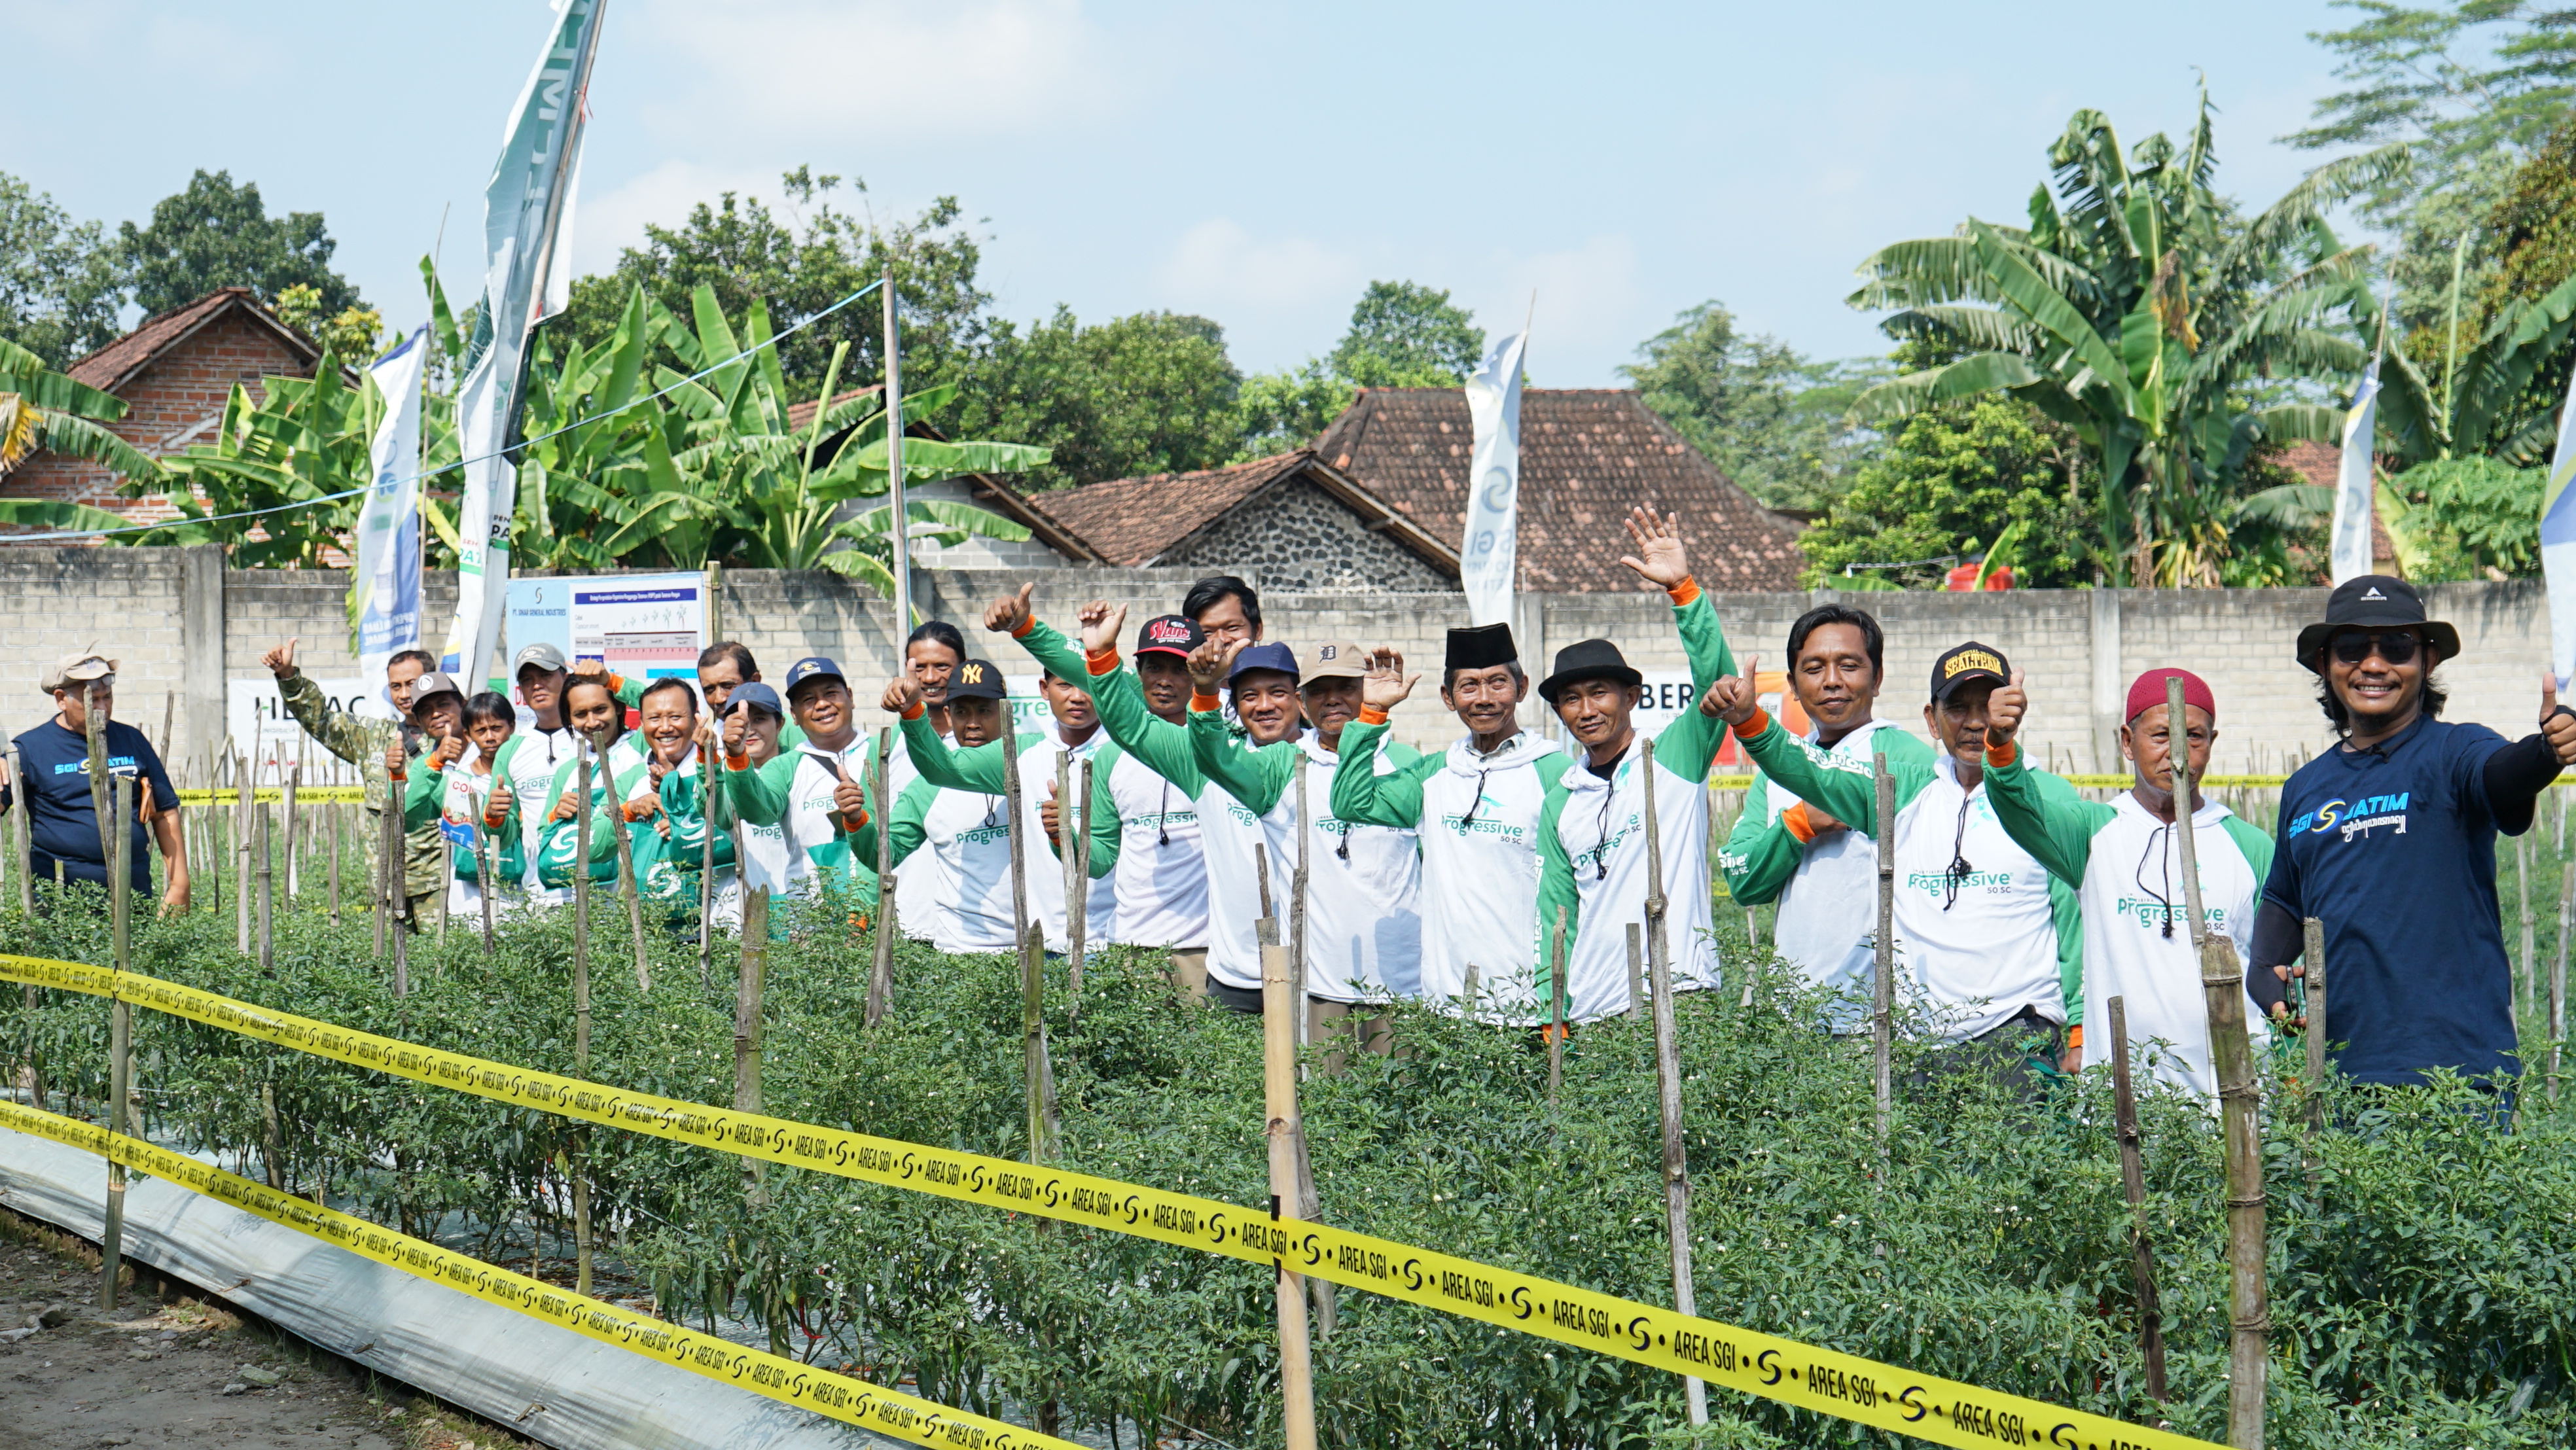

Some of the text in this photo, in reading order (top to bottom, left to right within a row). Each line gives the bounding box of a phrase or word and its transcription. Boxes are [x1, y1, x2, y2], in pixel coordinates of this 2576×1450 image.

[54, 756, 135, 775] SGI ATIM
[803, 799, 834, 811] Prog
[2289, 811, 2314, 839] SGI
[2342, 792, 2409, 822] JATIM
[753, 827, 782, 840] Prog
[1908, 872, 2011, 896] Progressive
[482, 1070, 495, 1089] AREA
[495, 1073, 506, 1091] SGI
[527, 1081, 541, 1099] AREA
[541, 1084, 552, 1102] SGI
[575, 1092, 590, 1110] AREA
[590, 1095, 602, 1113] SGI
[625, 1101, 642, 1122] AREA
[641, 1105, 656, 1125] SGI
[678, 1113, 694, 1133] AREA
[695, 1116, 707, 1136] SGI
[734, 1123, 751, 1145] AREA
[753, 1127, 764, 1148] SGI
[795, 1135, 813, 1158] AREA
[814, 1138, 827, 1161] SGI
[857, 1146, 876, 1170] AREA
[878, 1150, 892, 1173] SGI
[925, 1159, 944, 1183] AREA
[946, 1163, 961, 1186] SGI
[996, 1173, 1017, 1197] AREA
[1019, 1176, 1034, 1201] SGI
[1072, 1188, 1094, 1213] AREA
[1096, 1192, 1111, 1217] SGI
[1154, 1204, 1177, 1231] AREA
[1180, 1209, 1195, 1235] SGI
[1243, 1223, 1268, 1250] AREA
[1270, 1229, 1287, 1256] SGI
[1339, 1245, 1367, 1275] AREA
[1370, 1252, 1387, 1281] SGI
[1442, 1271, 1473, 1302] AREA
[1475, 1279, 1494, 1308] SGI
[1554, 1300, 1586, 1332] AREA
[1588, 1308, 1610, 1339] SGI
[1675, 1331, 1711, 1365] AREA
[1714, 1340, 1736, 1372] SGI
[1808, 1365, 1848, 1400] AREA
[1851, 1375, 1876, 1407] SGI
[1952, 1402, 1996, 1438] AREA
[1998, 1412, 2026, 1445] SGI
[406, 1248, 419, 1266] AREA
[419, 1252, 429, 1270] SGI
[448, 1262, 462, 1281] AREA
[461, 1267, 473, 1285] SGI
[493, 1278, 507, 1297] AREA
[506, 1282, 518, 1301] SGI
[539, 1294, 554, 1314] AREA
[554, 1300, 566, 1318] SGI
[588, 1310, 605, 1332] AREA
[603, 1315, 619, 1337] SGI
[639, 1326, 656, 1349] AREA
[656, 1332, 671, 1354] SGI
[694, 1344, 712, 1367] AREA
[711, 1349, 726, 1372] SGI
[752, 1362, 771, 1387] AREA
[770, 1368, 785, 1391] SGI
[813, 1380, 834, 1406] AREA
[832, 1386, 848, 1410] SGI
[878, 1400, 900, 1426] AREA
[899, 1406, 916, 1431] SGI
[946, 1420, 967, 1447] AREA
[969, 1426, 986, 1450] SGI
